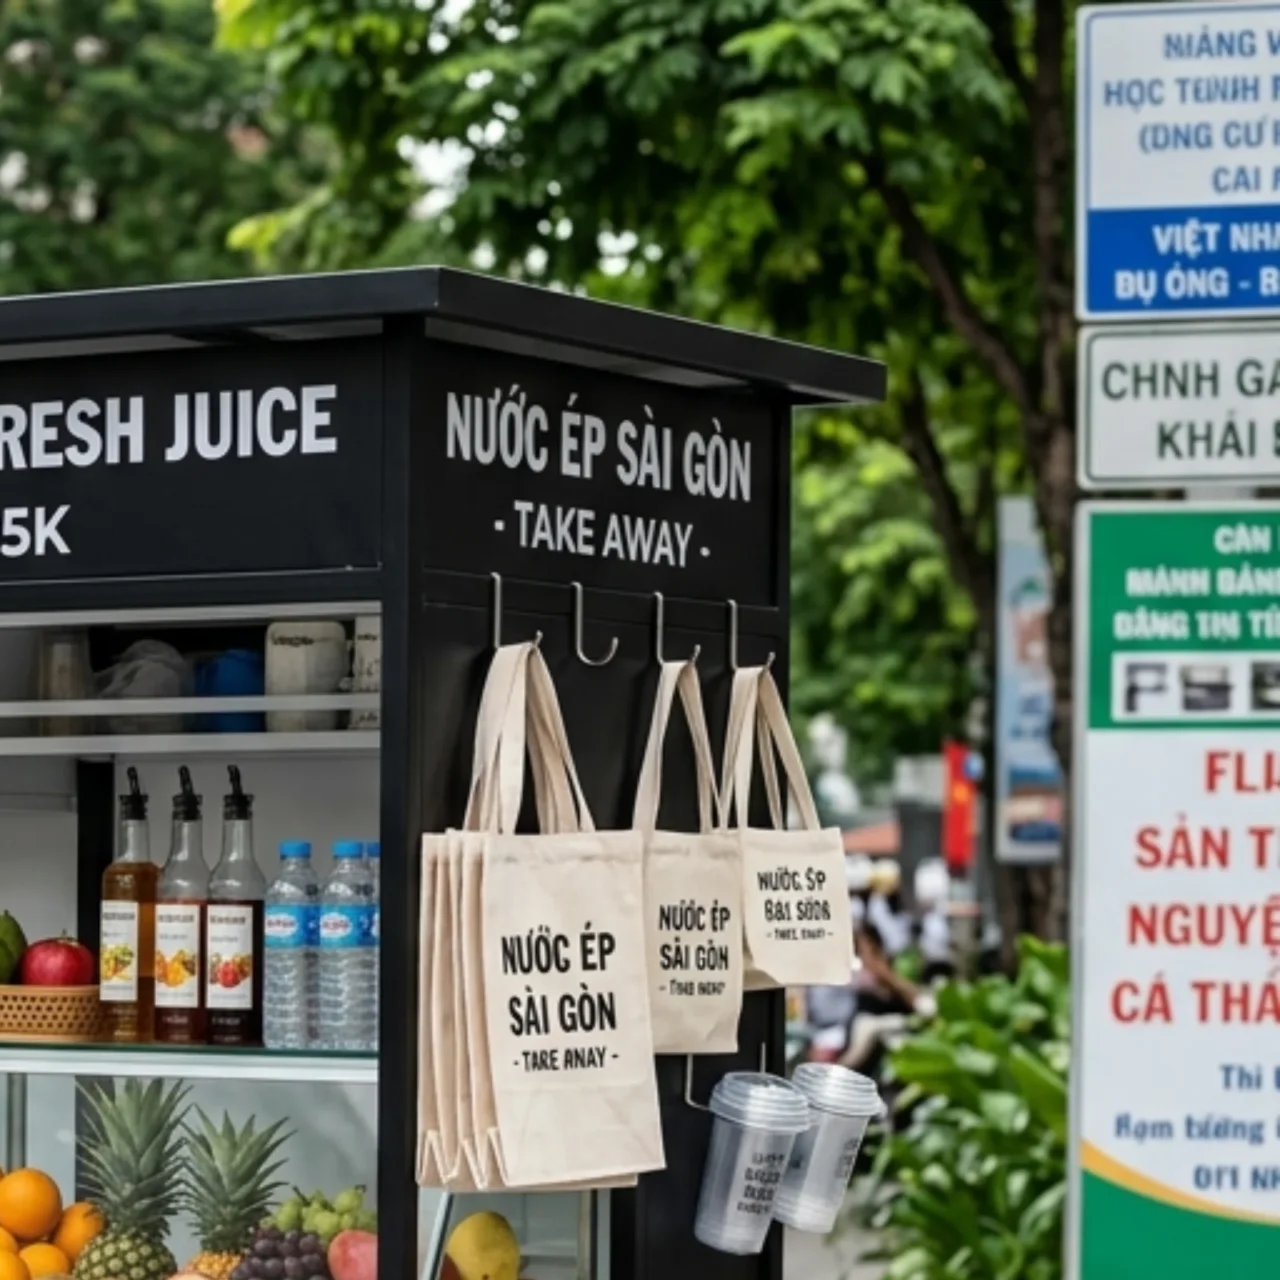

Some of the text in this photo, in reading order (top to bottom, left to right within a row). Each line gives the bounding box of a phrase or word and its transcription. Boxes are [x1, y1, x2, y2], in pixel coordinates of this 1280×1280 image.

[1102, 360, 1218, 400] CHNH
[165, 384, 337, 462] JUICE
[447, 383, 751, 502] NƯỚC ÉP SÀI GÒN
[514, 501, 595, 556] TAKE
[602, 512, 693, 568] AWAY
[580, 921, 616, 971] ÉP
[509, 982, 616, 1037] SÀI GÒN
